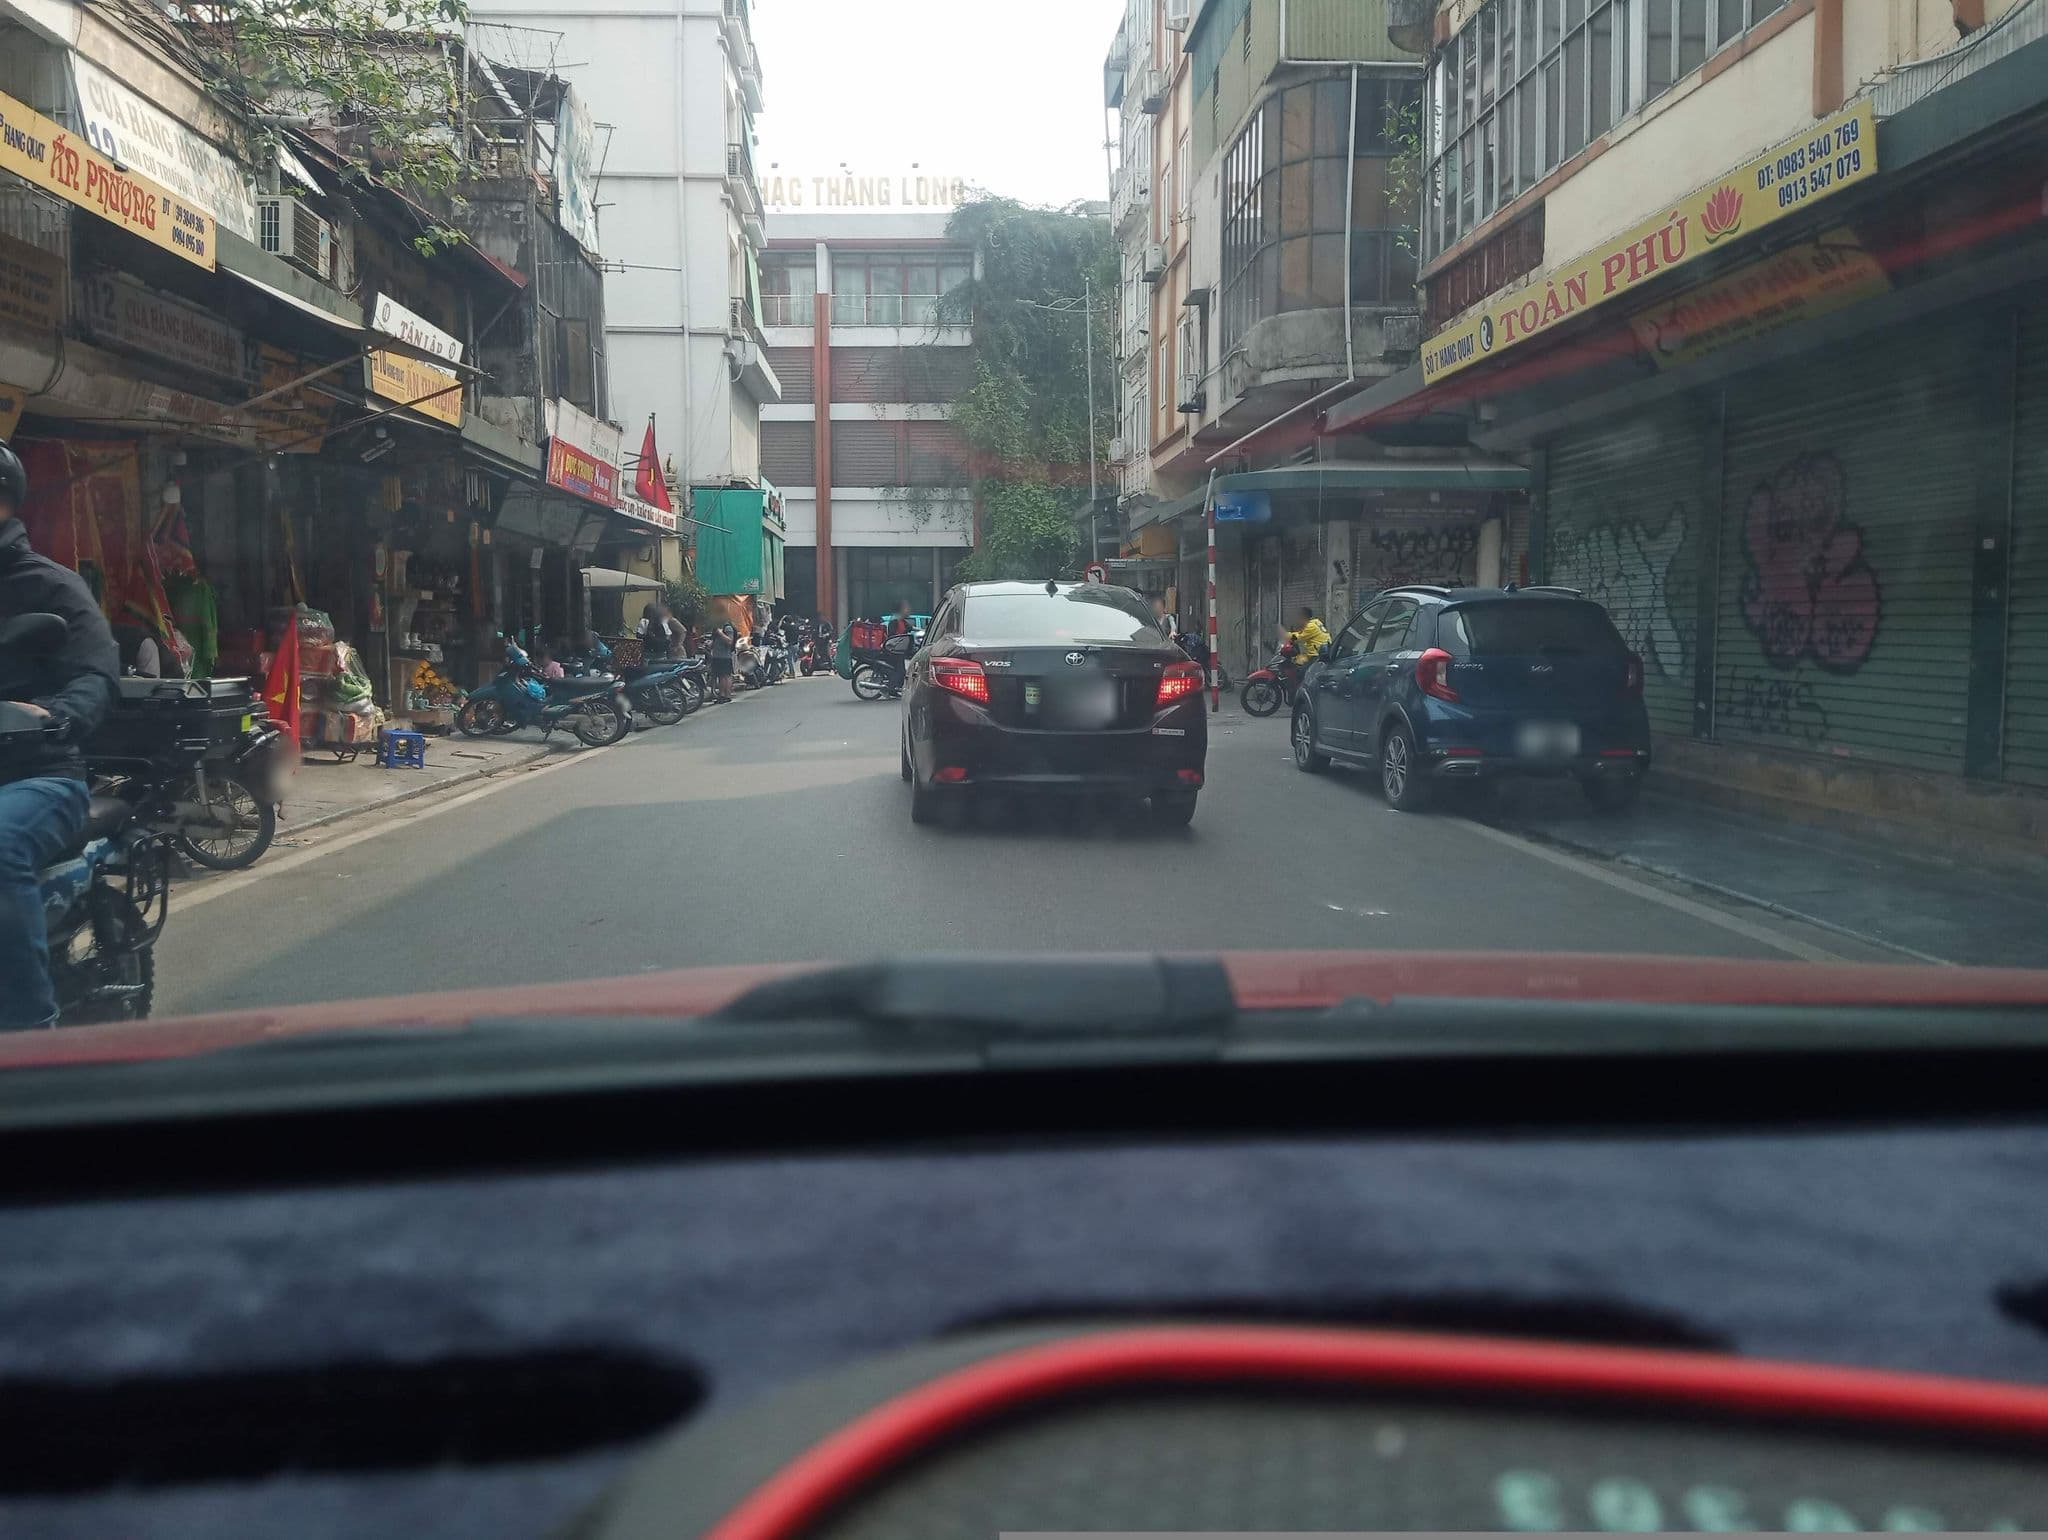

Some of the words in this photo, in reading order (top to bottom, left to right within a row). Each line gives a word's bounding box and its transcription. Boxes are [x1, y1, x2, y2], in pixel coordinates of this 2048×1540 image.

[1776, 148, 1805, 181] 0983
[1808, 133, 1831, 164] 540
[1833, 118, 1859, 151] 769
[1778, 174, 1807, 208] 0913
[1810, 160, 1832, 194] 547
[1836, 148, 1861, 180] 079
[812, 169, 891, 206] THĂNG
[1601, 210, 1688, 296] PHÚ
[1440, 343, 1456, 369] HÀNG
[1457, 333, 1474, 361] QUẠT
